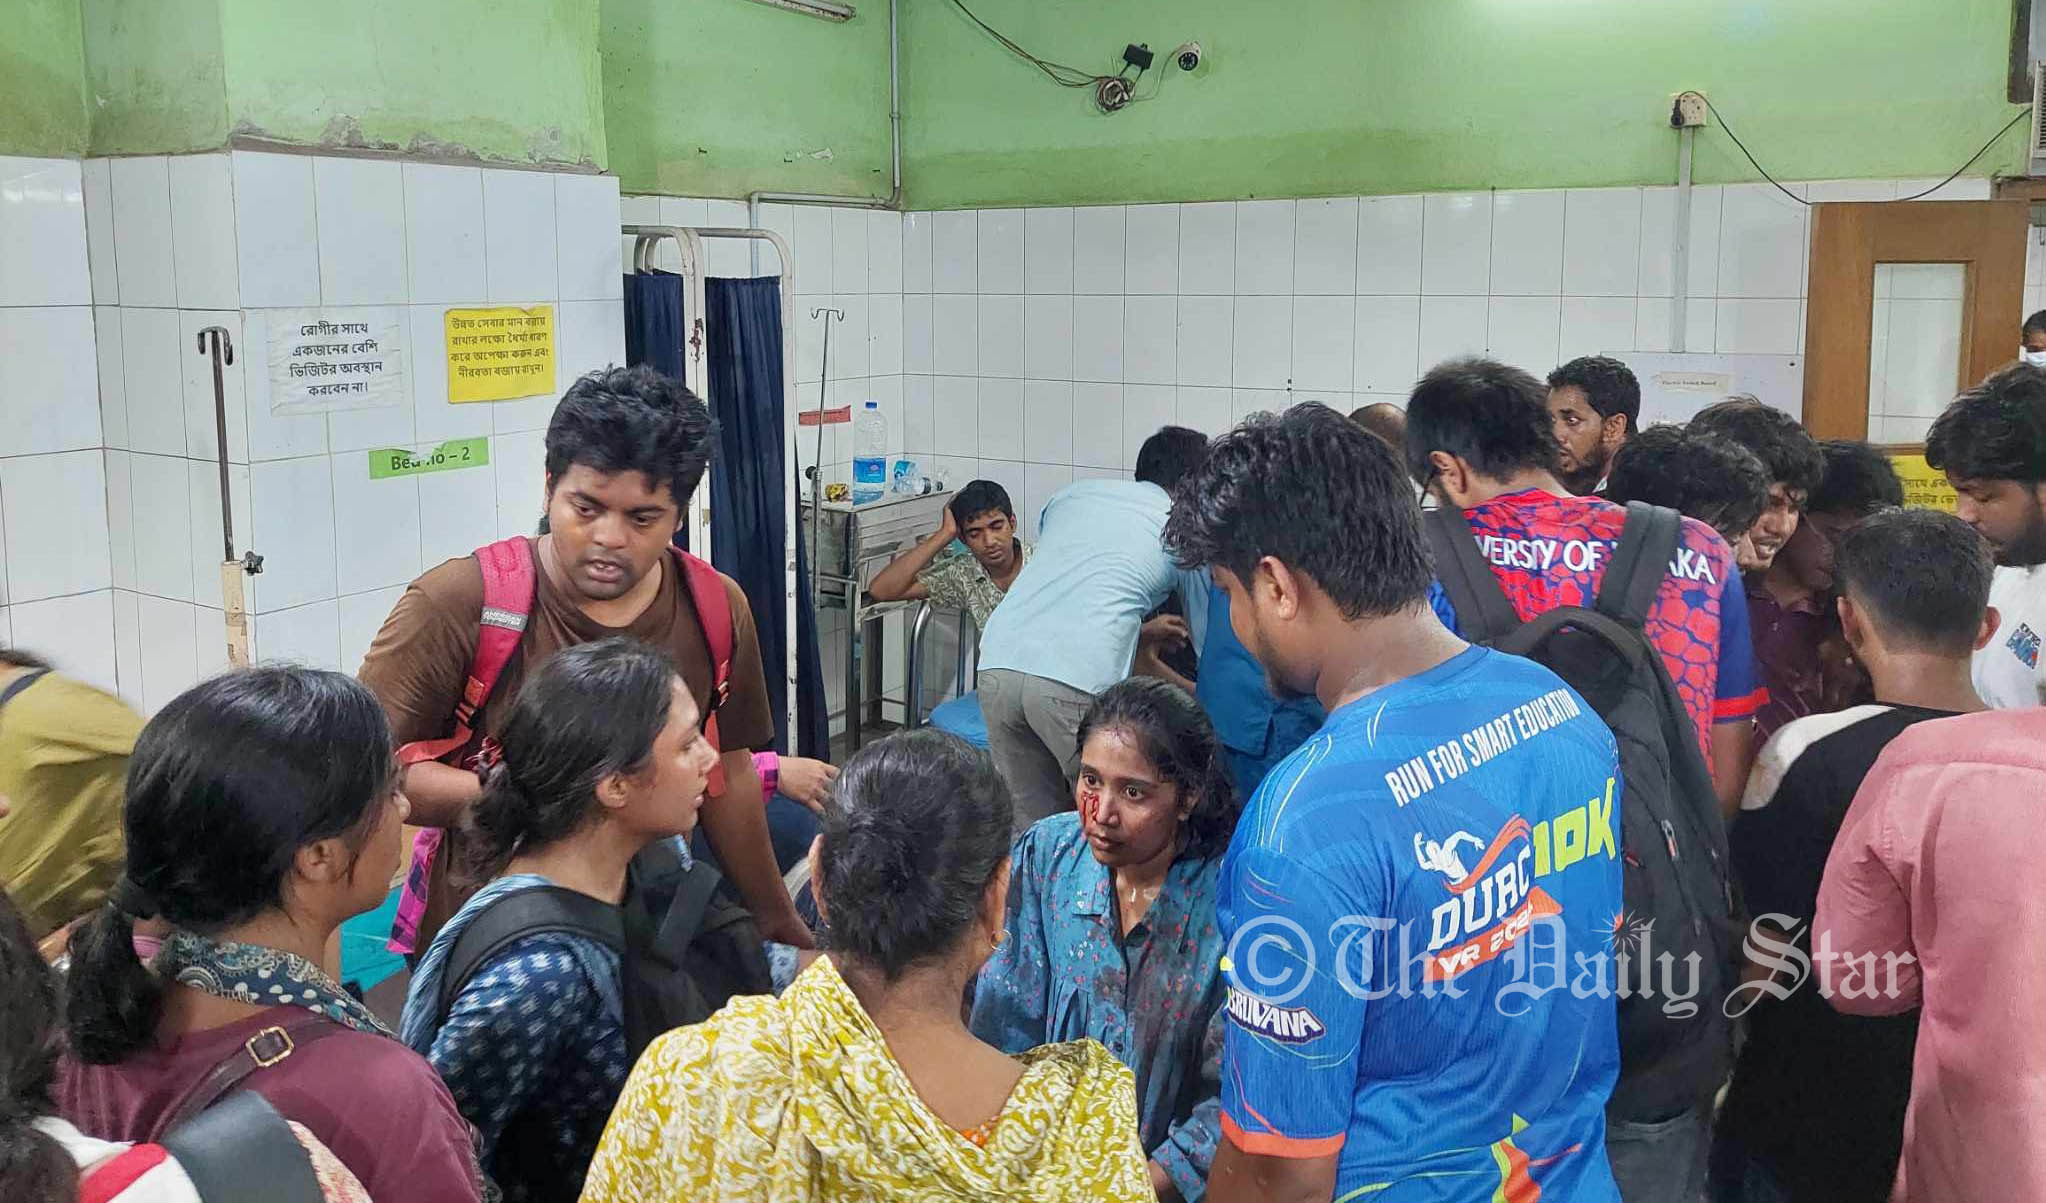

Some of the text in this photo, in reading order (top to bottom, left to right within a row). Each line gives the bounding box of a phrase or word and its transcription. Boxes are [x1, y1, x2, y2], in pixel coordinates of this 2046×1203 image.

[300, 321, 368, 336] রোগীর সাথে
[507, 318, 522, 327] মান
[292, 339, 378, 357] একজনের বেশি
[450, 352, 471, 362] করে
[289, 361, 383, 377] ভিজিটর অবস্থান
[306, 382, 368, 396] করবেন না।
[462, 447, 470, 460] 2
[1474, 535, 1602, 571] VERSITY OF
[1385, 756, 1434, 807] RUN
[1427, 740, 1469, 784] FOR
[1463, 713, 1517, 768] SMART
[1533, 777, 1616, 878] 10K
